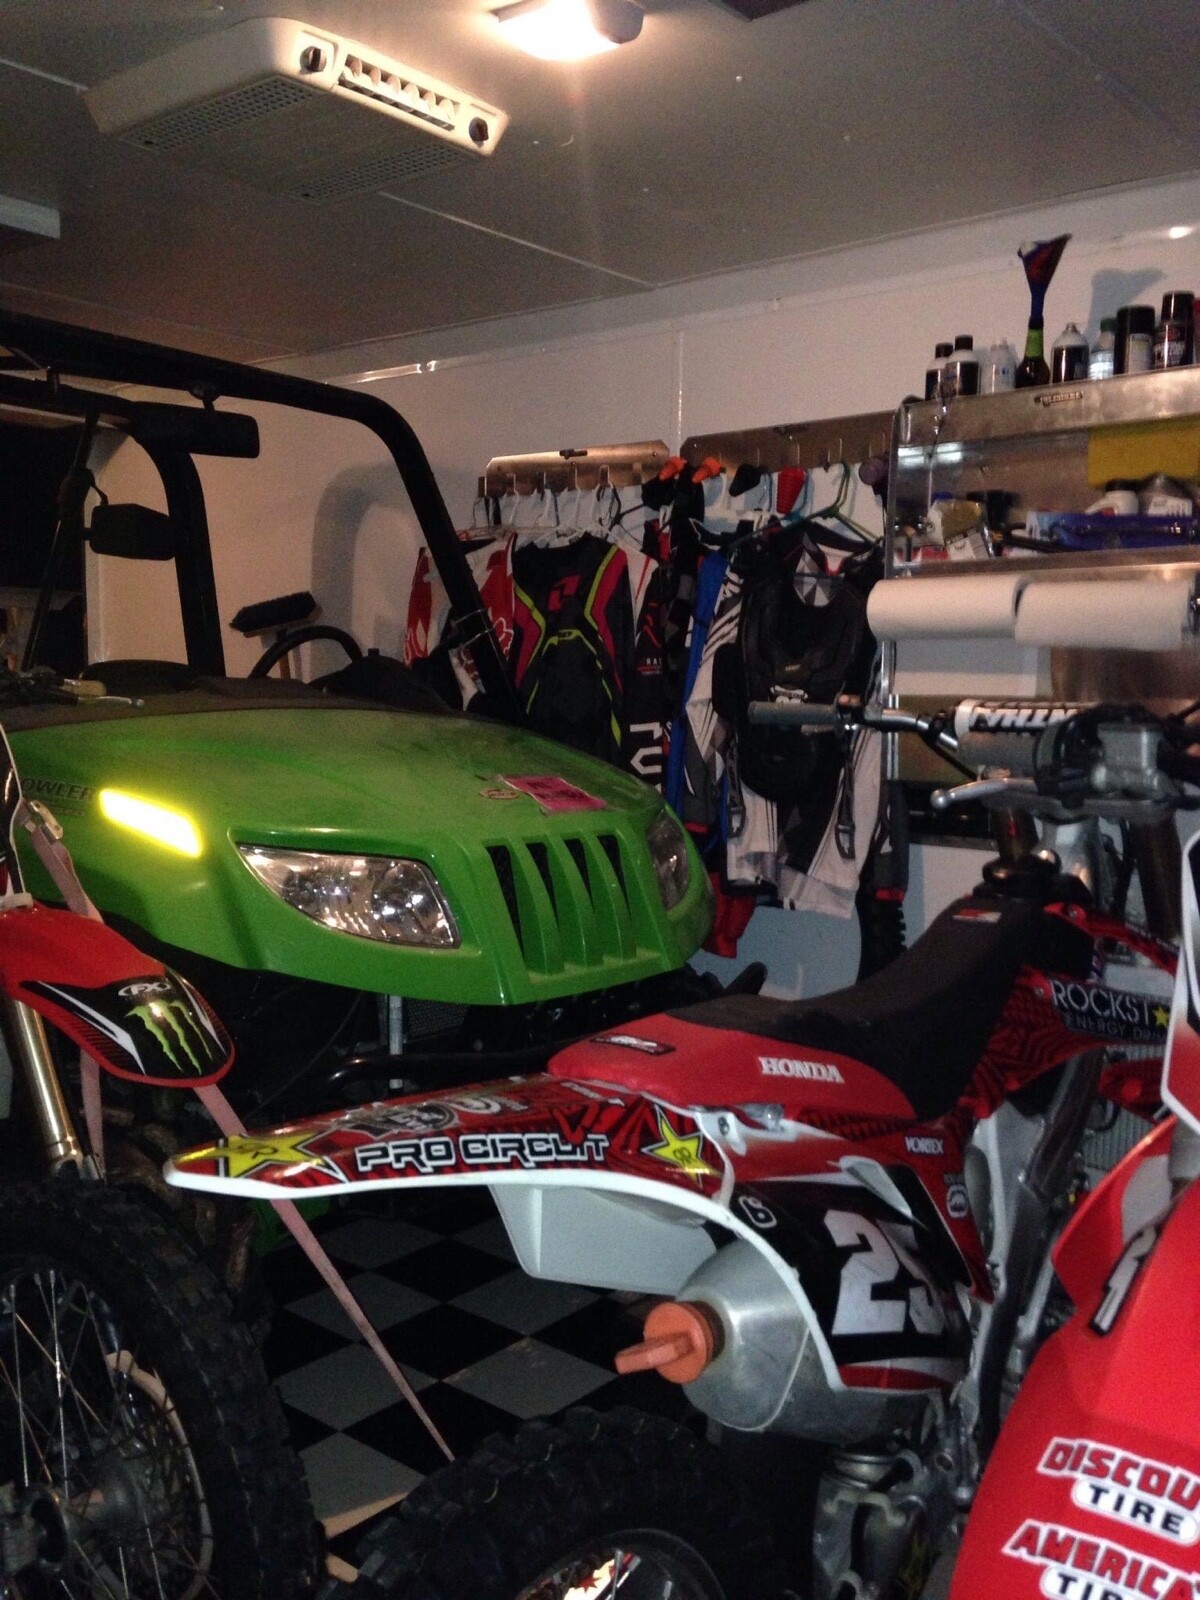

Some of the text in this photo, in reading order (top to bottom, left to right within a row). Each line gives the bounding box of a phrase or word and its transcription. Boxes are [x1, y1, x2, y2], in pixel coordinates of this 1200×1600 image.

[22, 777, 96, 801] OWLER
[758, 1056, 845, 1084] HONDA
[355, 1132, 609, 1173] PRO CIRCUIT
[1089, 1483, 1184, 1535] TIRE
[1006, 1520, 1200, 1600] AMERICA
